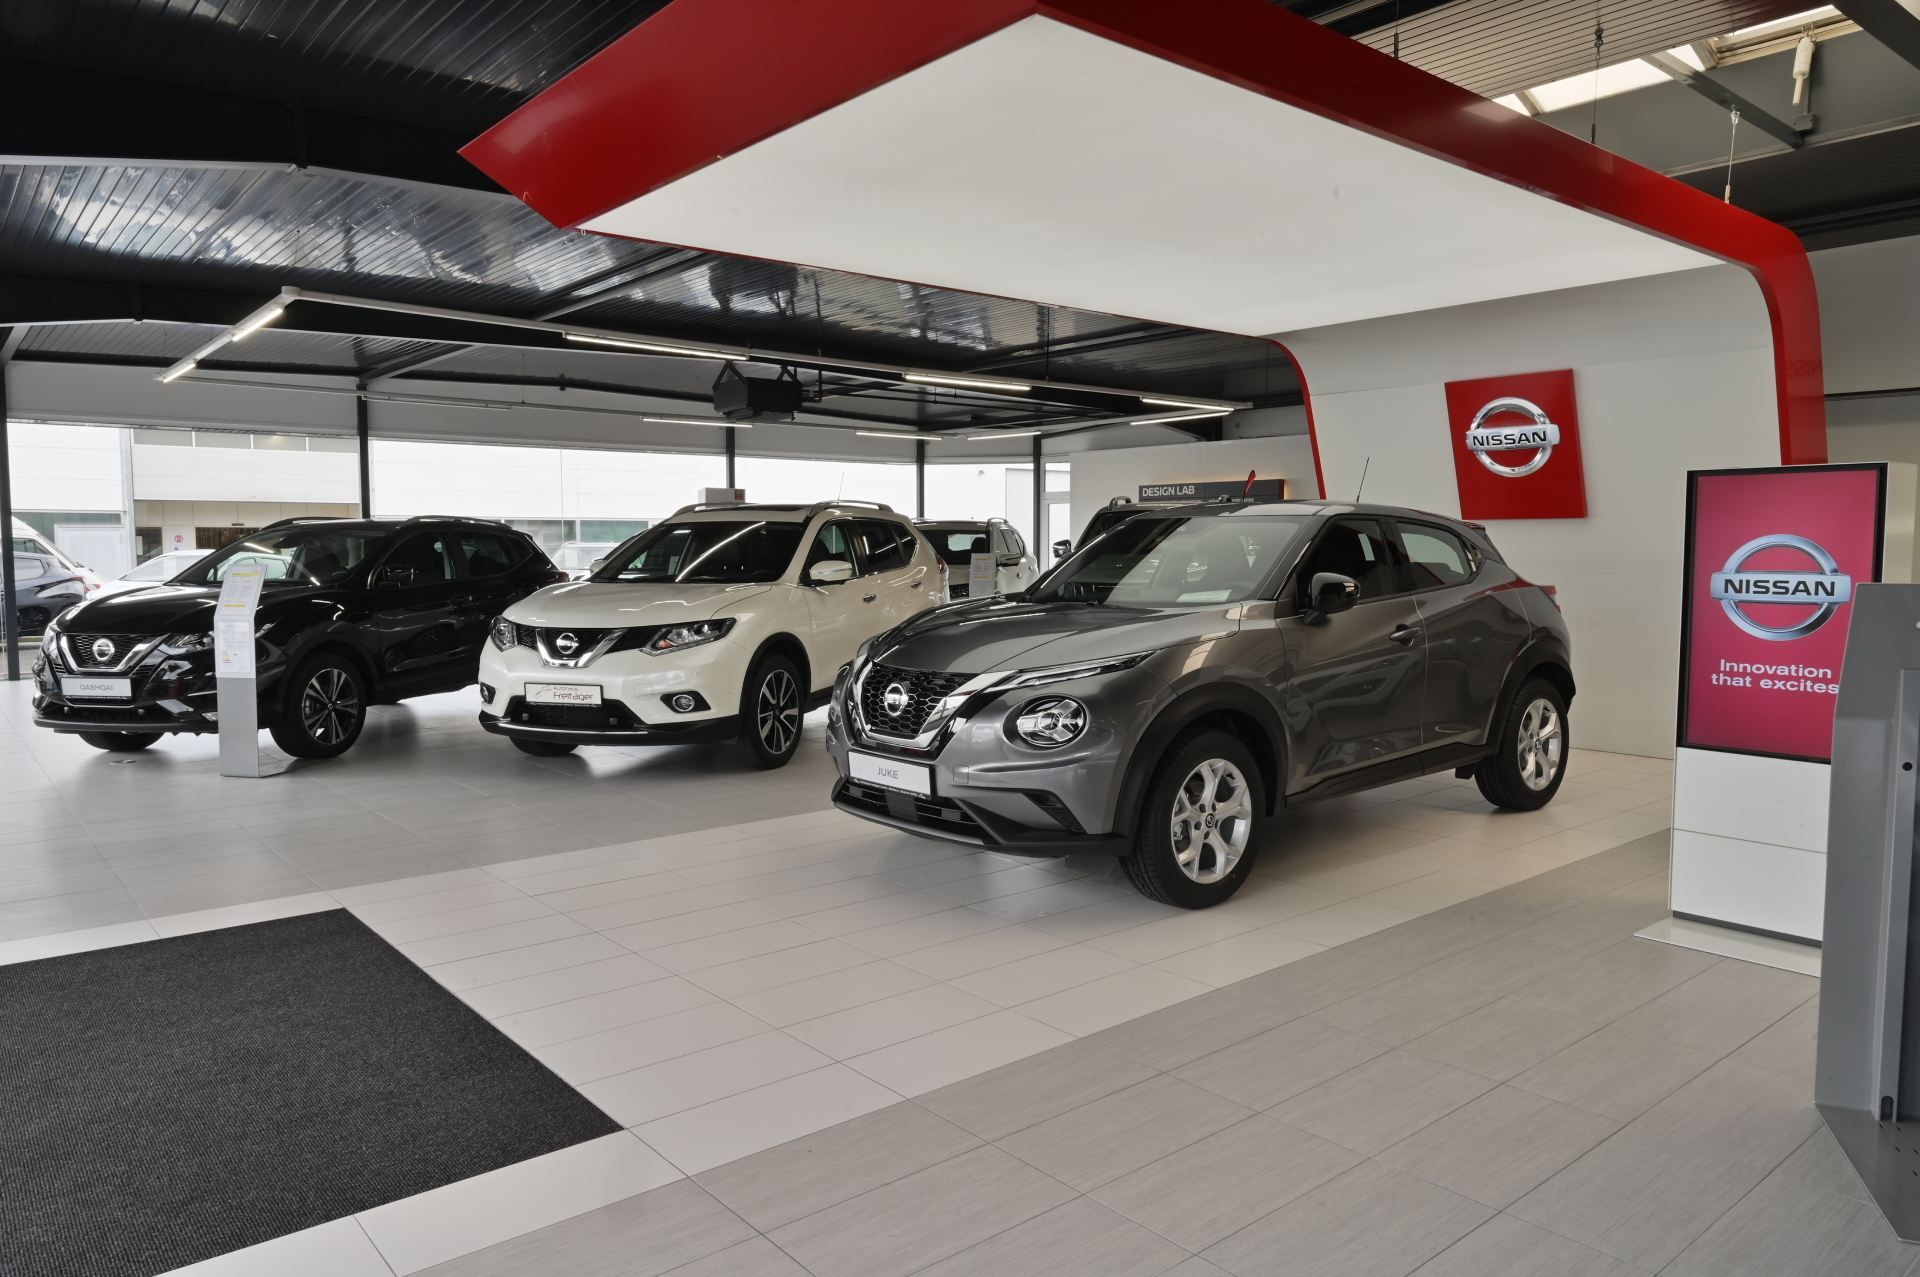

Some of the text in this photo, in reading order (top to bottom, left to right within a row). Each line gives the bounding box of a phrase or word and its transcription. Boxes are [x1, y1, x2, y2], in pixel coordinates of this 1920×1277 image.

[1472, 430, 1547, 447] NISSAN
[1142, 485, 1195, 497] DESIGN LAB
[1723, 578, 1836, 597] NISSAN
[1720, 658, 1832, 679] Innovation
[1711, 673, 1839, 695] that excites
[878, 766, 899, 780] JUKE
